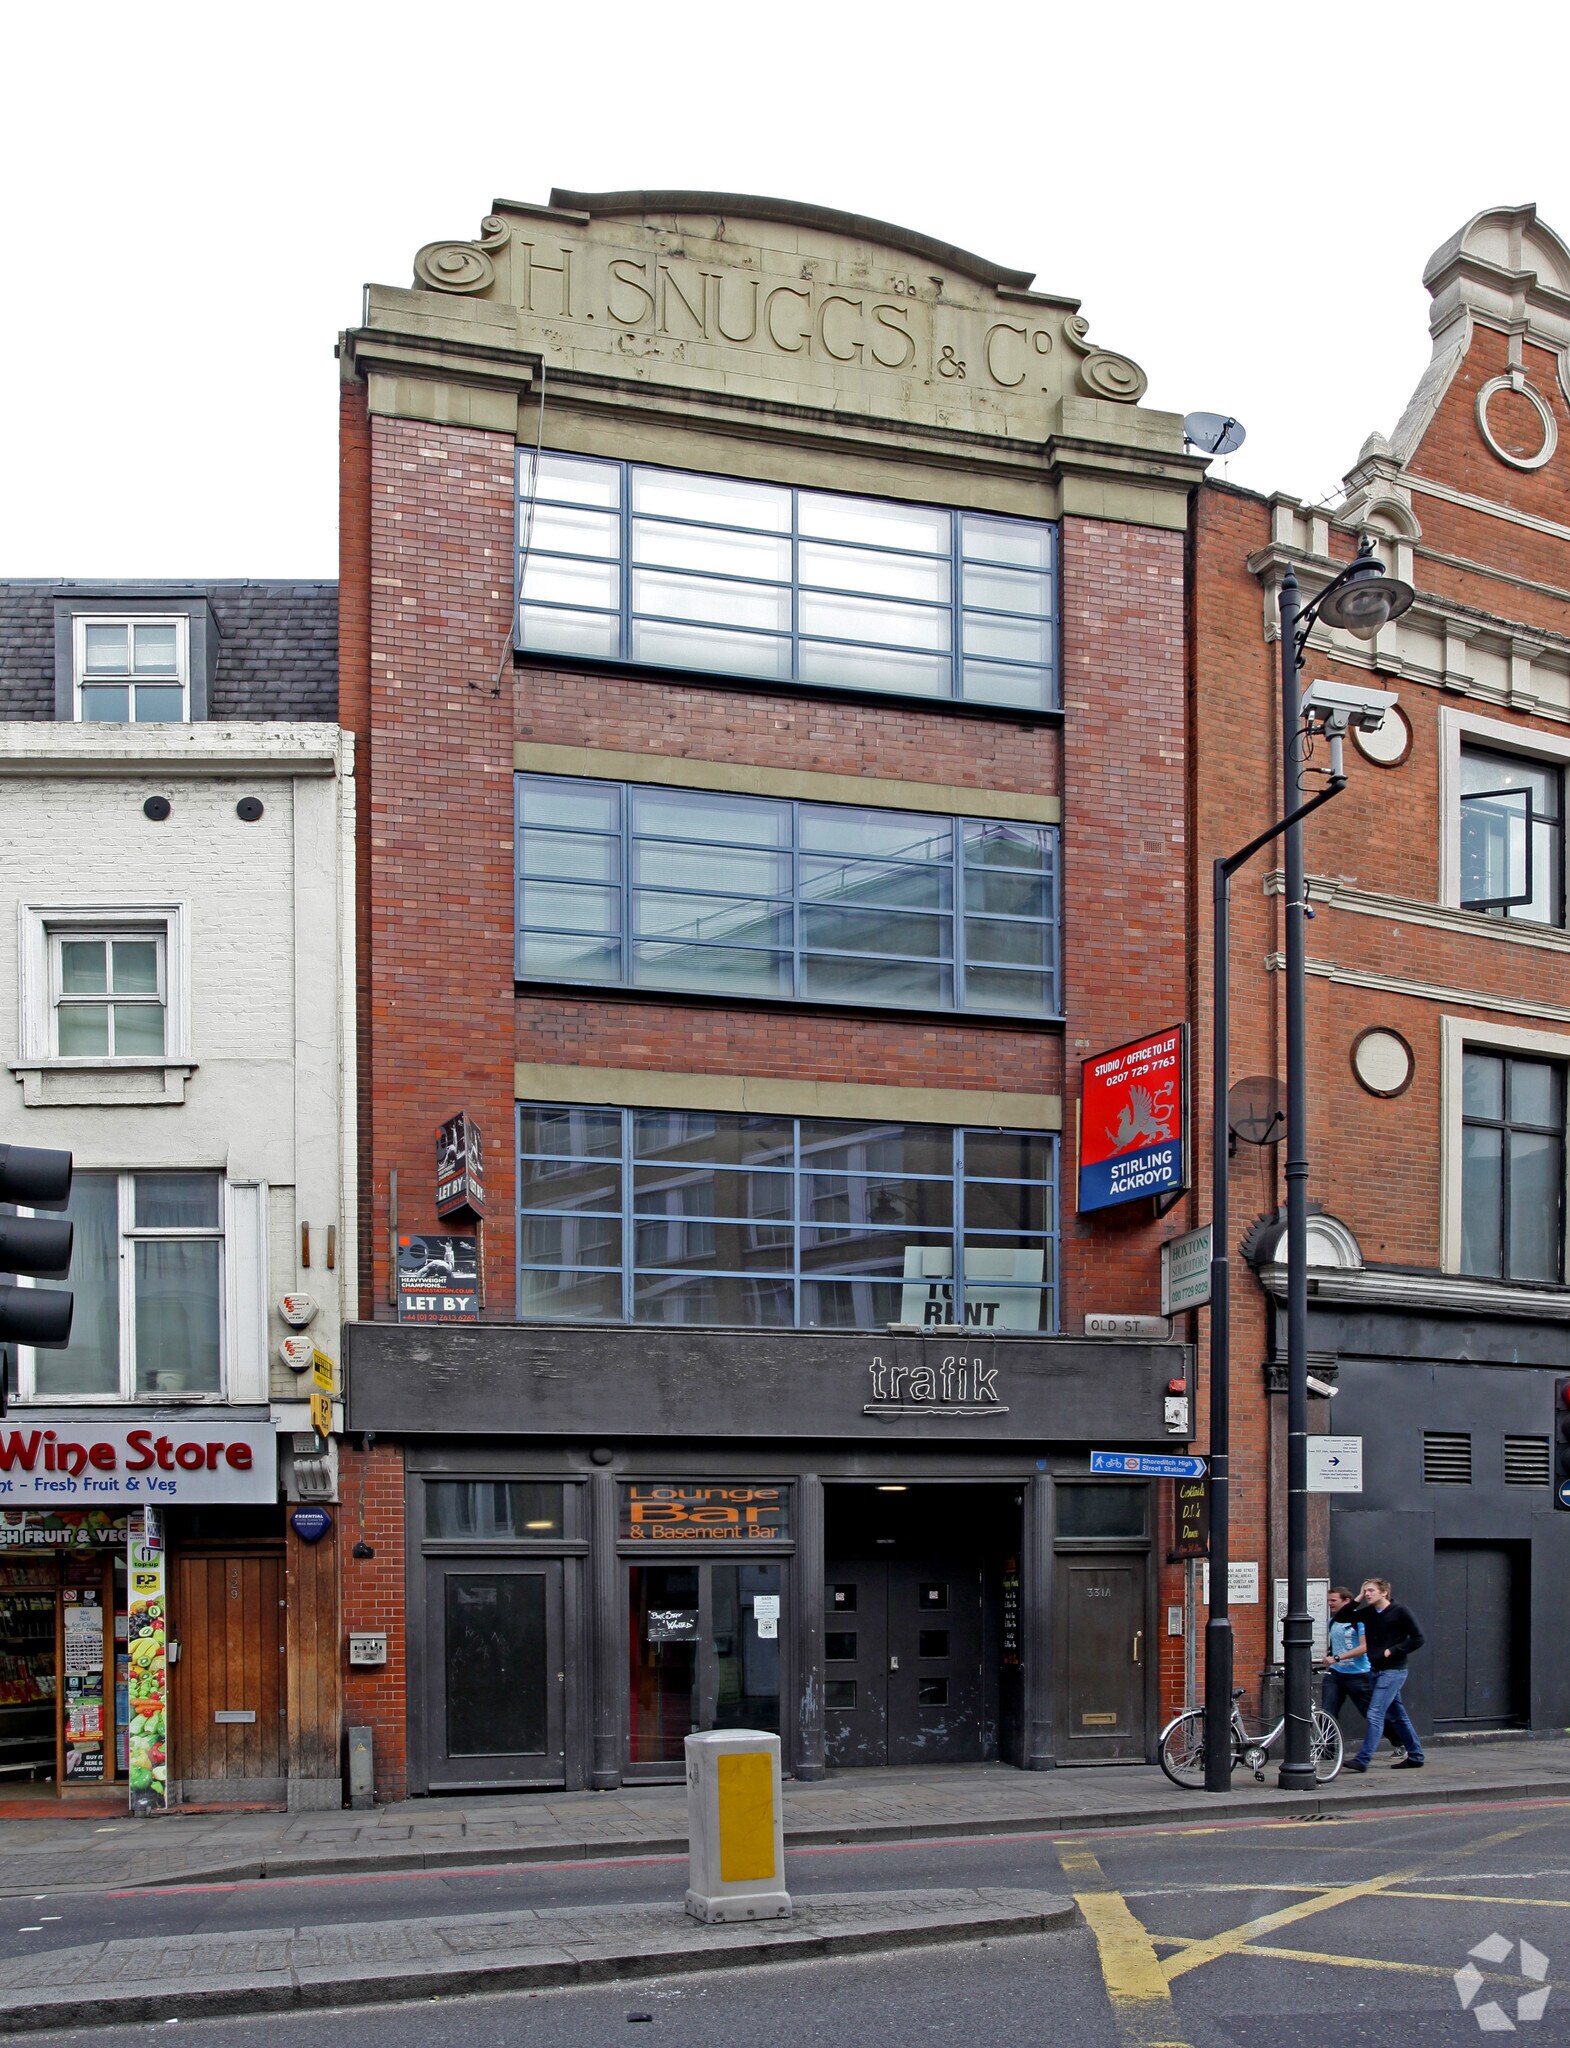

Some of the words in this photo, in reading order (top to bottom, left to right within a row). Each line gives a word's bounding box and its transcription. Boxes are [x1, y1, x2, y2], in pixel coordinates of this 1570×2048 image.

[606, 259, 917, 370] SNUGGS
[936, 345, 966, 380] &
[1095, 1058, 1120, 1077] STUDIO
[1127, 1047, 1152, 1065] OFFICE
[1152, 1043, 1162, 1056] TO
[1163, 1038, 1176, 1052] LET
[1106, 1071, 1128, 1087] 0207
[1131, 1064, 1149, 1078] 729
[1152, 1055, 1175, 1071] 7763
[1111, 1150, 1172, 1179] STIRLING
[438, 1182, 451, 1201] LET
[452, 1176, 463, 1194] BY
[1109, 1166, 1172, 1195] ACKROYD
[1172, 1235, 1209, 1261] HOXTONS
[1172, 1255, 1208, 1278] SOLICITORS
[406, 1296, 437, 1310] LET
[443, 1297, 470, 1311] BY
[1172, 1291, 1181, 1302] 020
[1182, 1286, 1194, 1300] 7729
[924, 1302, 1000, 1326] RENT
[1091, 1319, 1117, 1332] OLD
[1124, 1320, 1145, 1333] ST.
[868, 1356, 1000, 1401] trafik
[0, 1430, 117, 1477] Wine
[125, 1429, 253, 1471] Store
[1142, 1458, 1176, 1466] Shoreditch
[1163, 1465, 1186, 1473] Station
[34, 1477, 77, 1494] Fresh
[83, 1477, 119, 1492] Fruit
[125, 1476, 140, 1491] &
[146, 1476, 177, 1495] Veg
[630, 1486, 779, 1503] Lounge
[1180, 1482, 1205, 1498] Cocktails
[630, 1502, 780, 1523] Bar
[25, 1530, 72, 1543] FRUIT
[77, 1529, 91, 1543] &
[630, 1524, 646, 1539] &
[652, 1524, 742, 1539] Basement
[748, 1524, 779, 1539] Bar
[1086, 1588, 1112, 1597] 331A
